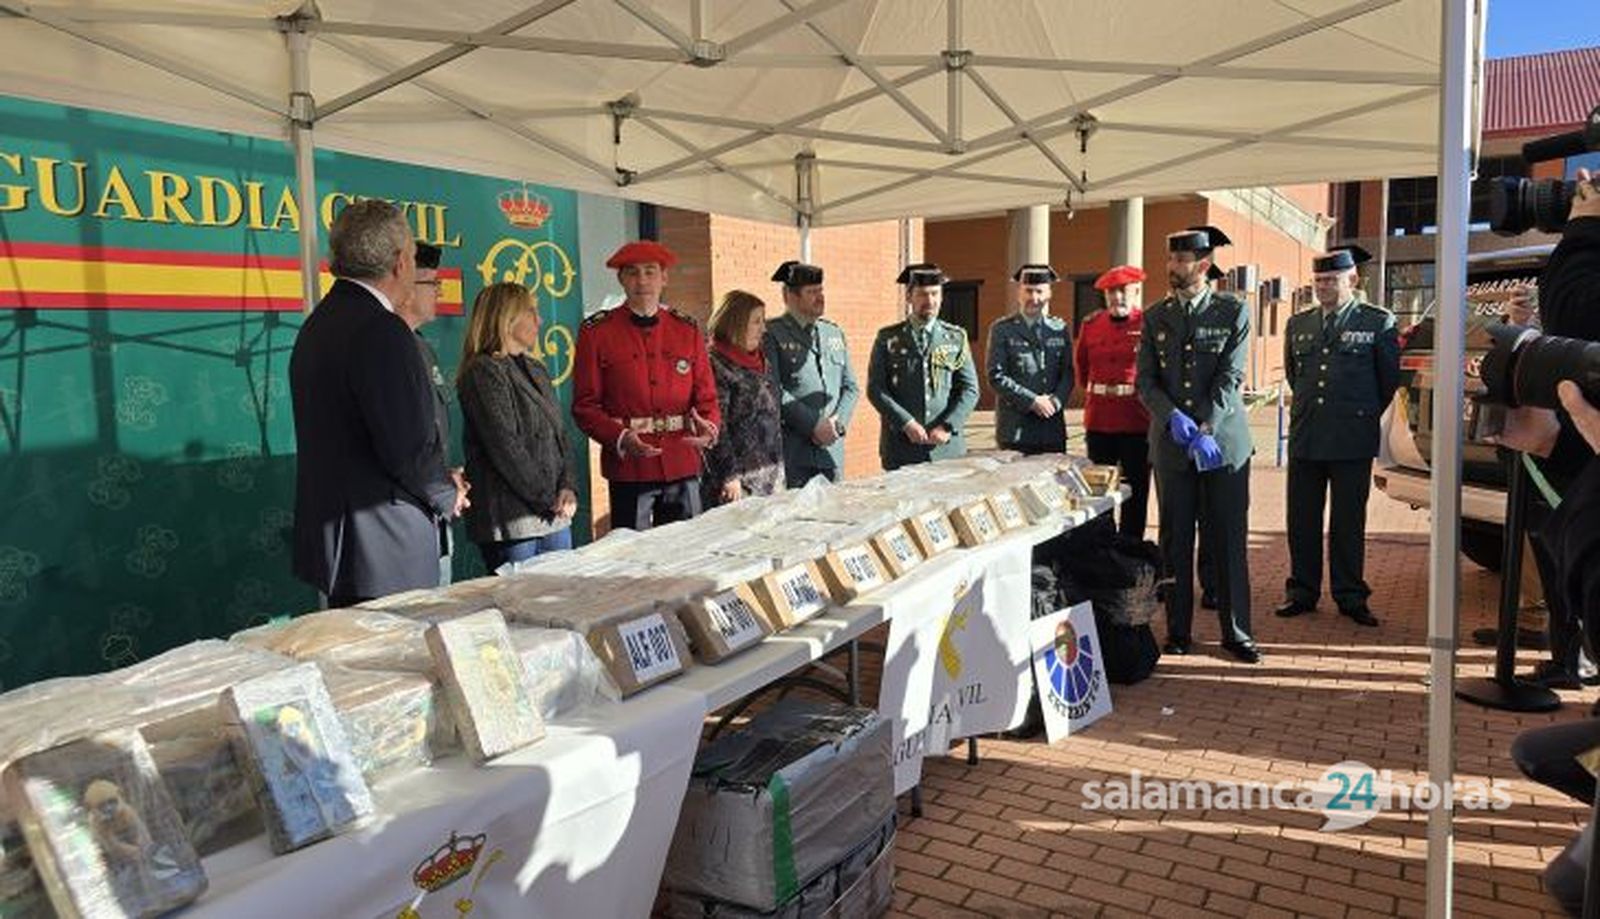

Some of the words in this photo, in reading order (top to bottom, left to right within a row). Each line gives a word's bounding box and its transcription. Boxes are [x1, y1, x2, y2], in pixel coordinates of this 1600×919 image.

[0, 152, 300, 232] GUARDIA
[321, 191, 463, 247] CIL
[625, 629, 652, 671] ALF
